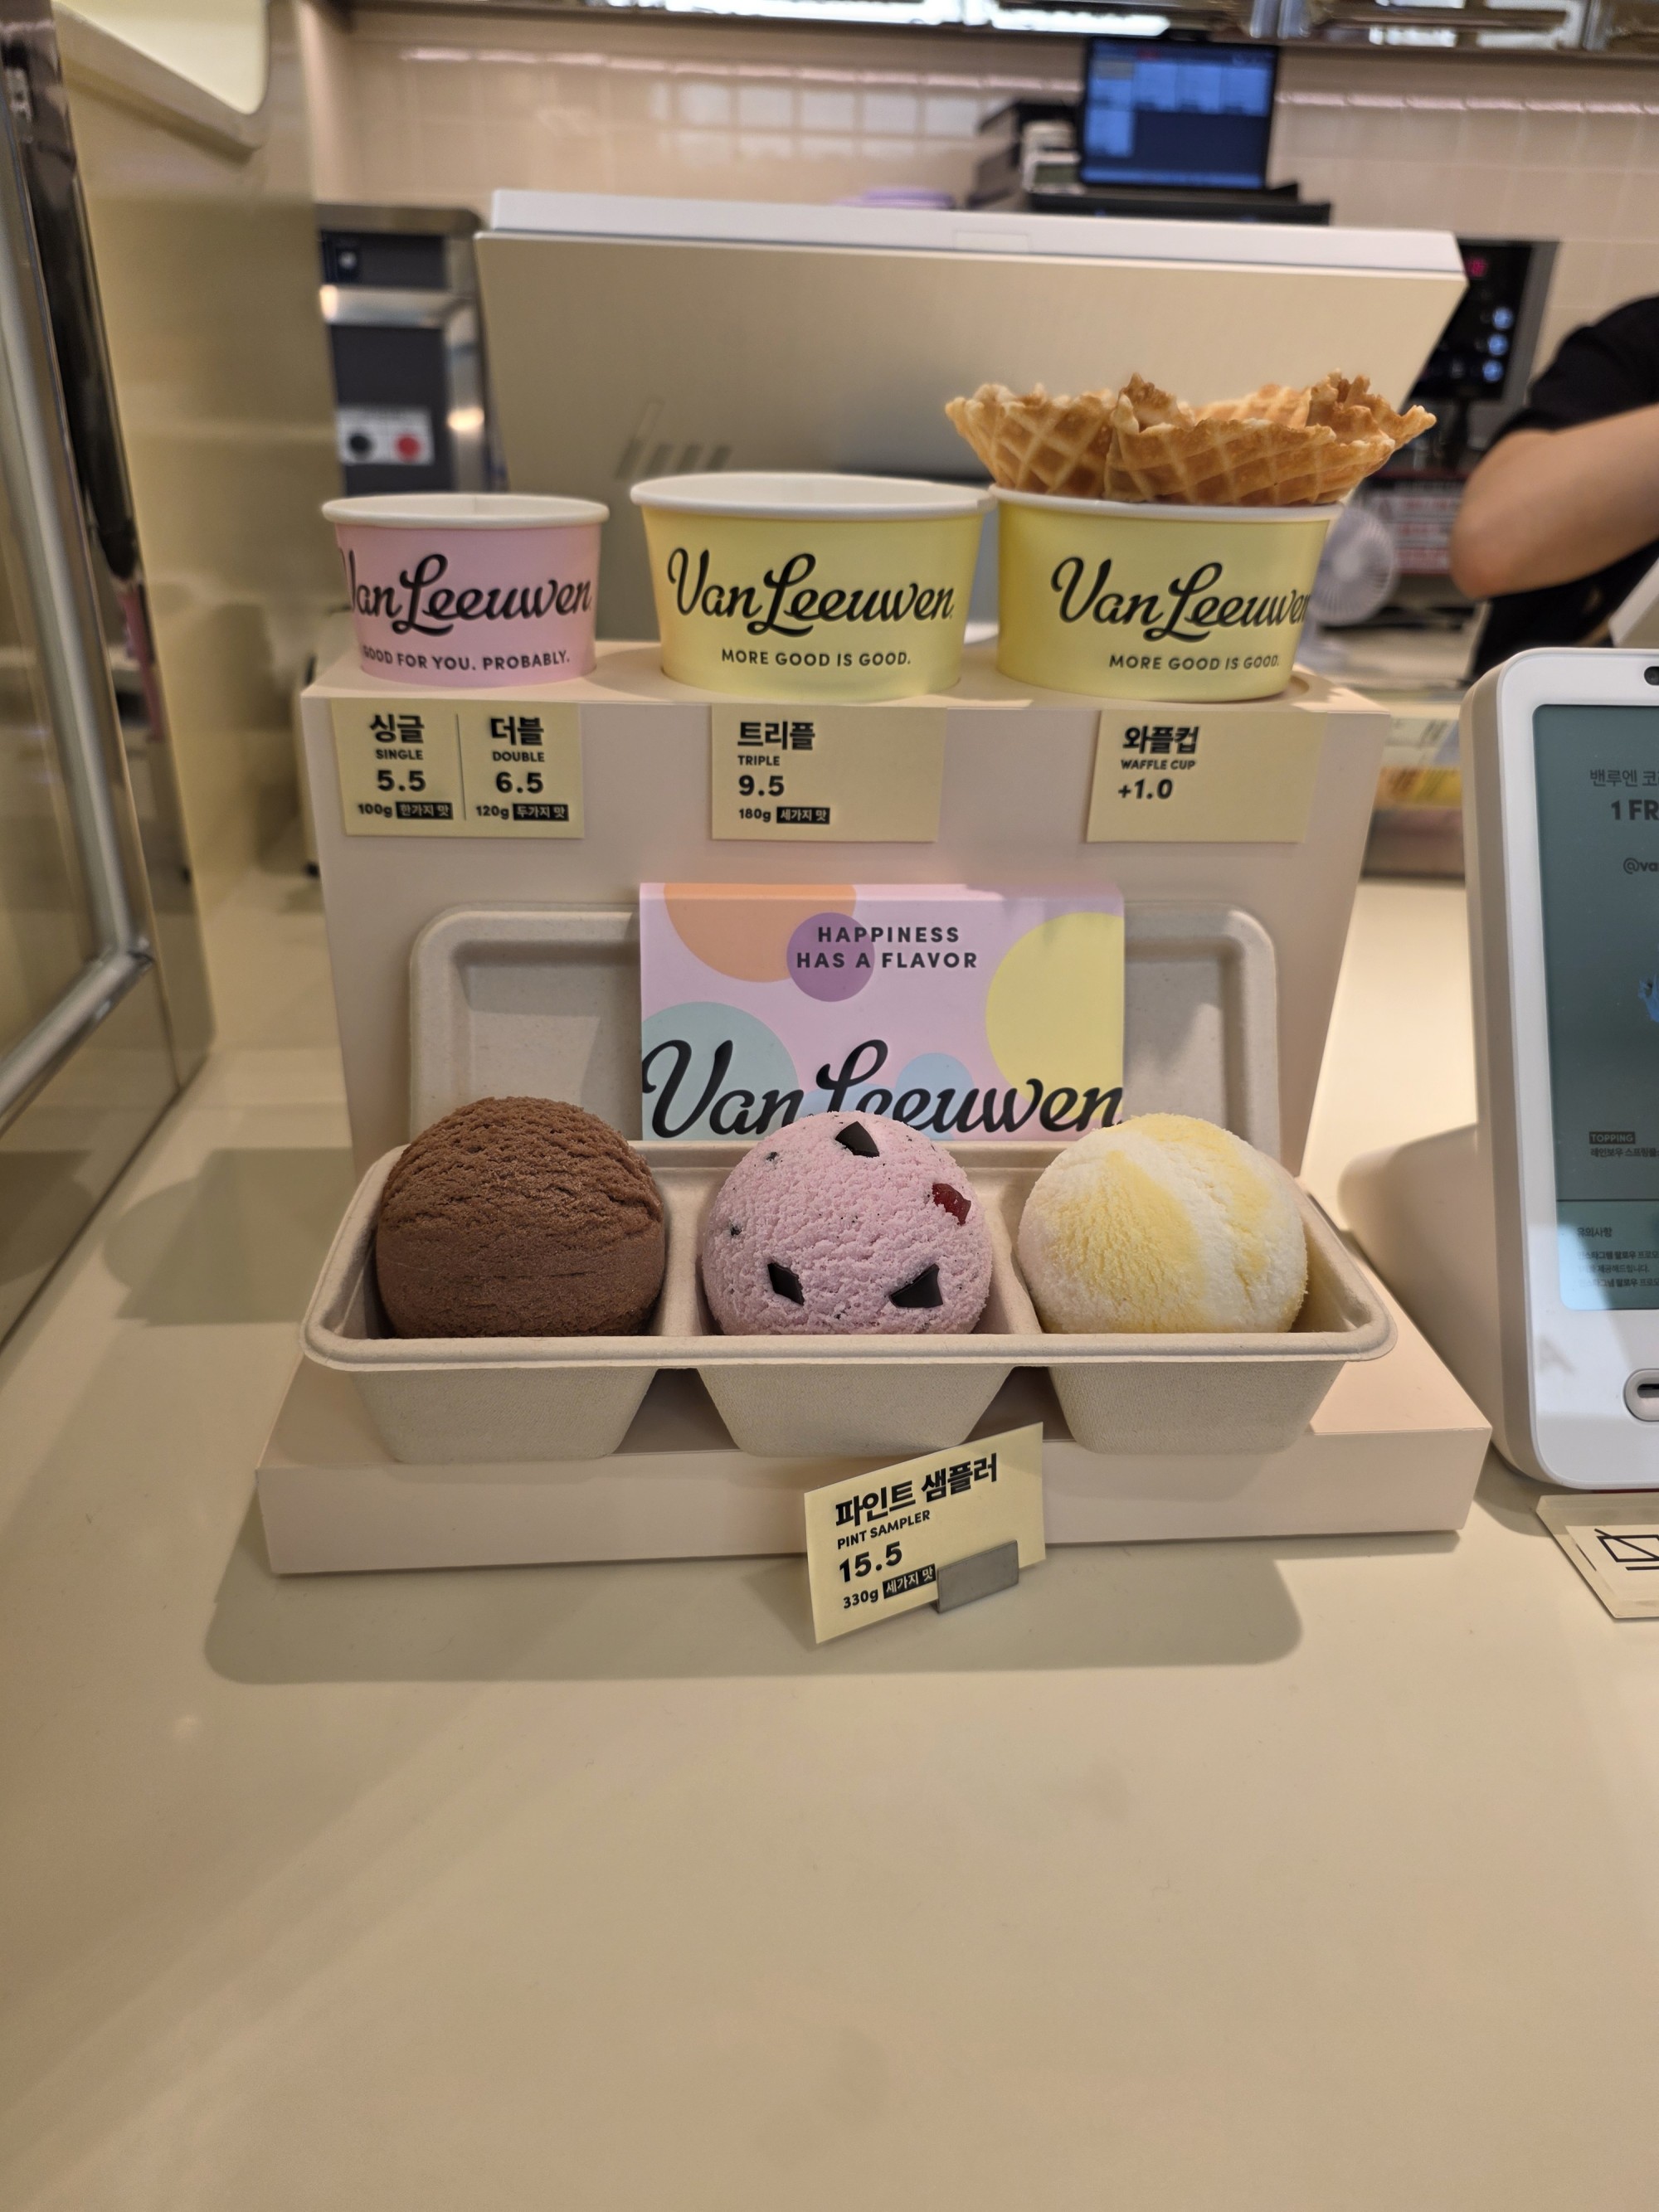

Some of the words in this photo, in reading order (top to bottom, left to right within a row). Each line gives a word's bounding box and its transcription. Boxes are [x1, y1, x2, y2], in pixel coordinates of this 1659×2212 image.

[397, 653, 427, 669] FOR
[431, 656, 476, 670] YOU.
[484, 649, 570, 670] PROBABLY.
[722, 648, 769, 664] MORE
[776, 652, 830, 666] GOOD
[837, 652, 852, 667] IS
[859, 651, 912, 666] GOOD.
[1109, 654, 1161, 670] MORE
[1168, 657, 1219, 671] GOOD
[1225, 657, 1238, 670] IS
[1243, 654, 1279, 669] GOOD.
[370, 714, 425, 744] 싱글
[490, 716, 544, 746] 더블
[737, 721, 815, 751] 트리플
[1122, 726, 1200, 755] 와플컵
[376, 749, 424, 761] SINGLE
[492, 751, 545, 762] DOUBLE
[737, 755, 781, 766] TRIPLE
[1121, 759, 1167, 771] WAFFLE
[1170, 759, 1196, 771] CUP
[377, 770, 426, 792] 5.5
[496, 771, 544, 794] 6.5
[738, 775, 784, 796] 9.5
[1590, 769, 1637, 787] 밴루엔
[1642, 770, 1659, 786] 코
[1117, 778, 1174, 800] +1.0
[358, 804, 392, 818] 100g
[399, 804, 434, 816] 한가지
[437, 804, 449, 817] 맛
[475, 805, 509, 820] 120g
[516, 805, 551, 818] 두가지
[553, 805, 566, 819] 맛
[738, 808, 771, 823] 180g
[780, 808, 812, 821] 세가지
[815, 809, 827, 822] 맛
[1611, 800, 1621, 820] 1
[817, 926, 960, 944] HAPPINESS
[796, 951, 846, 969] HAS
[855, 951, 871, 969] A
[882, 951, 978, 969] FLAVOR
[642, 1038, 805, 1139] Van
[1591, 1133, 1633, 1143] TOPPING
[835, 1480, 916, 1527] 파인트
[921, 1452, 997, 1503] 샘플러
[837, 1530, 867, 1549] PINT
[870, 1510, 931, 1538] SAMPLER
[839, 1541, 902, 1582] 15.5
[843, 1588, 878, 1609] 330g
[886, 1571, 919, 1593] 세가지
[922, 1567, 935, 1582] 맛
